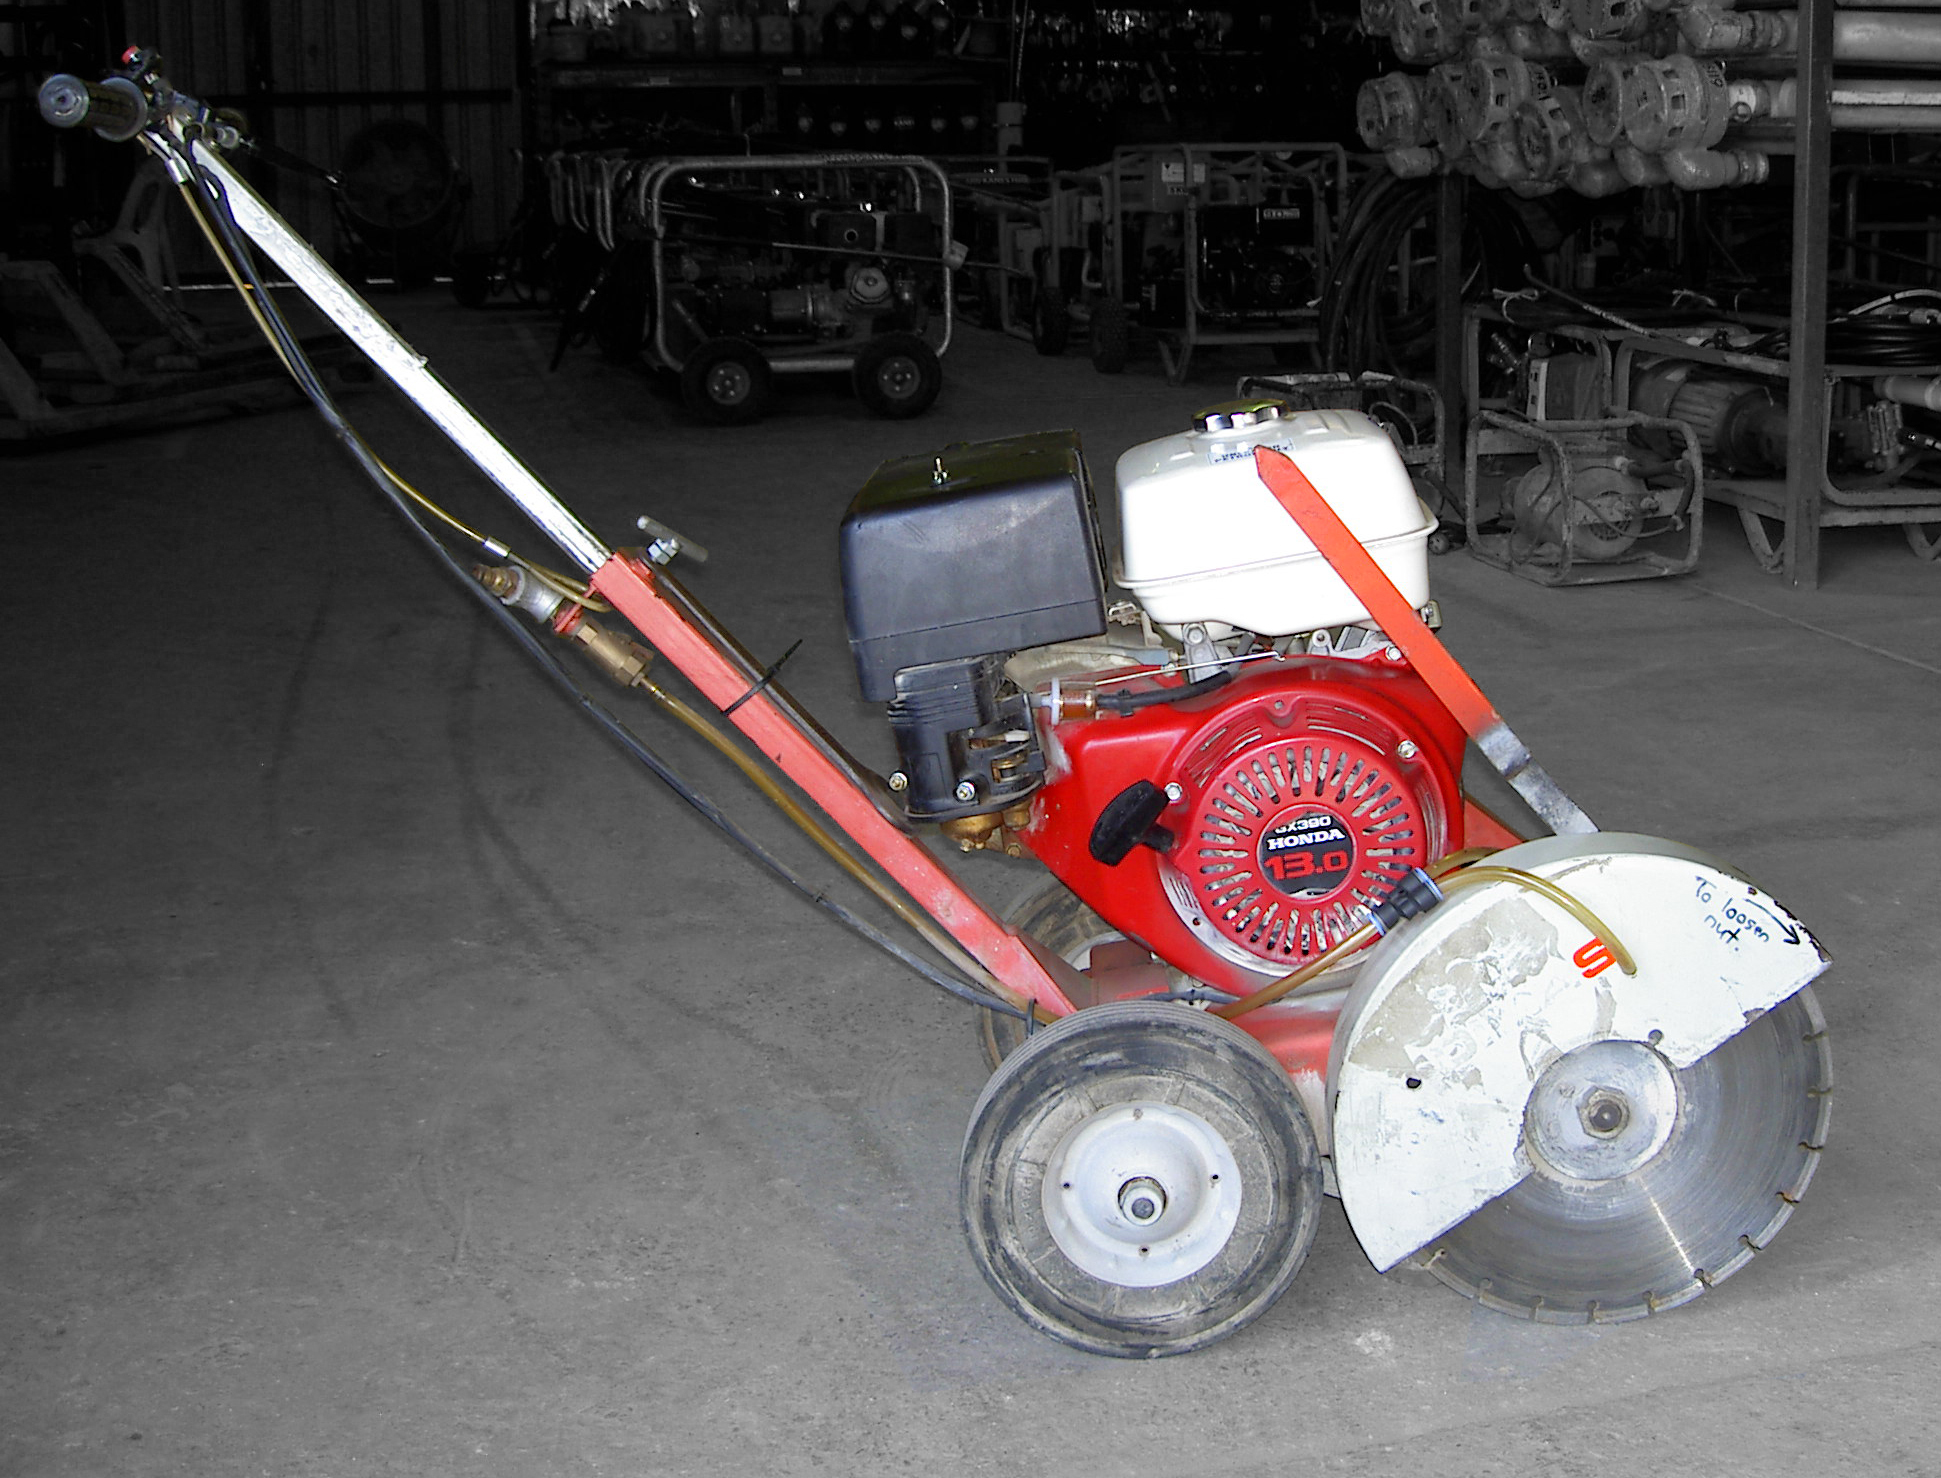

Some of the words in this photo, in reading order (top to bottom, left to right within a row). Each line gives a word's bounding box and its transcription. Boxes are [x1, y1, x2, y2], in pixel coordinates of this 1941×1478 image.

[1267, 828, 1345, 850] HONDA
[1264, 850, 1349, 880] 13.0
[1694, 875, 1717, 904] To
[1720, 897, 1770, 943] loosen
